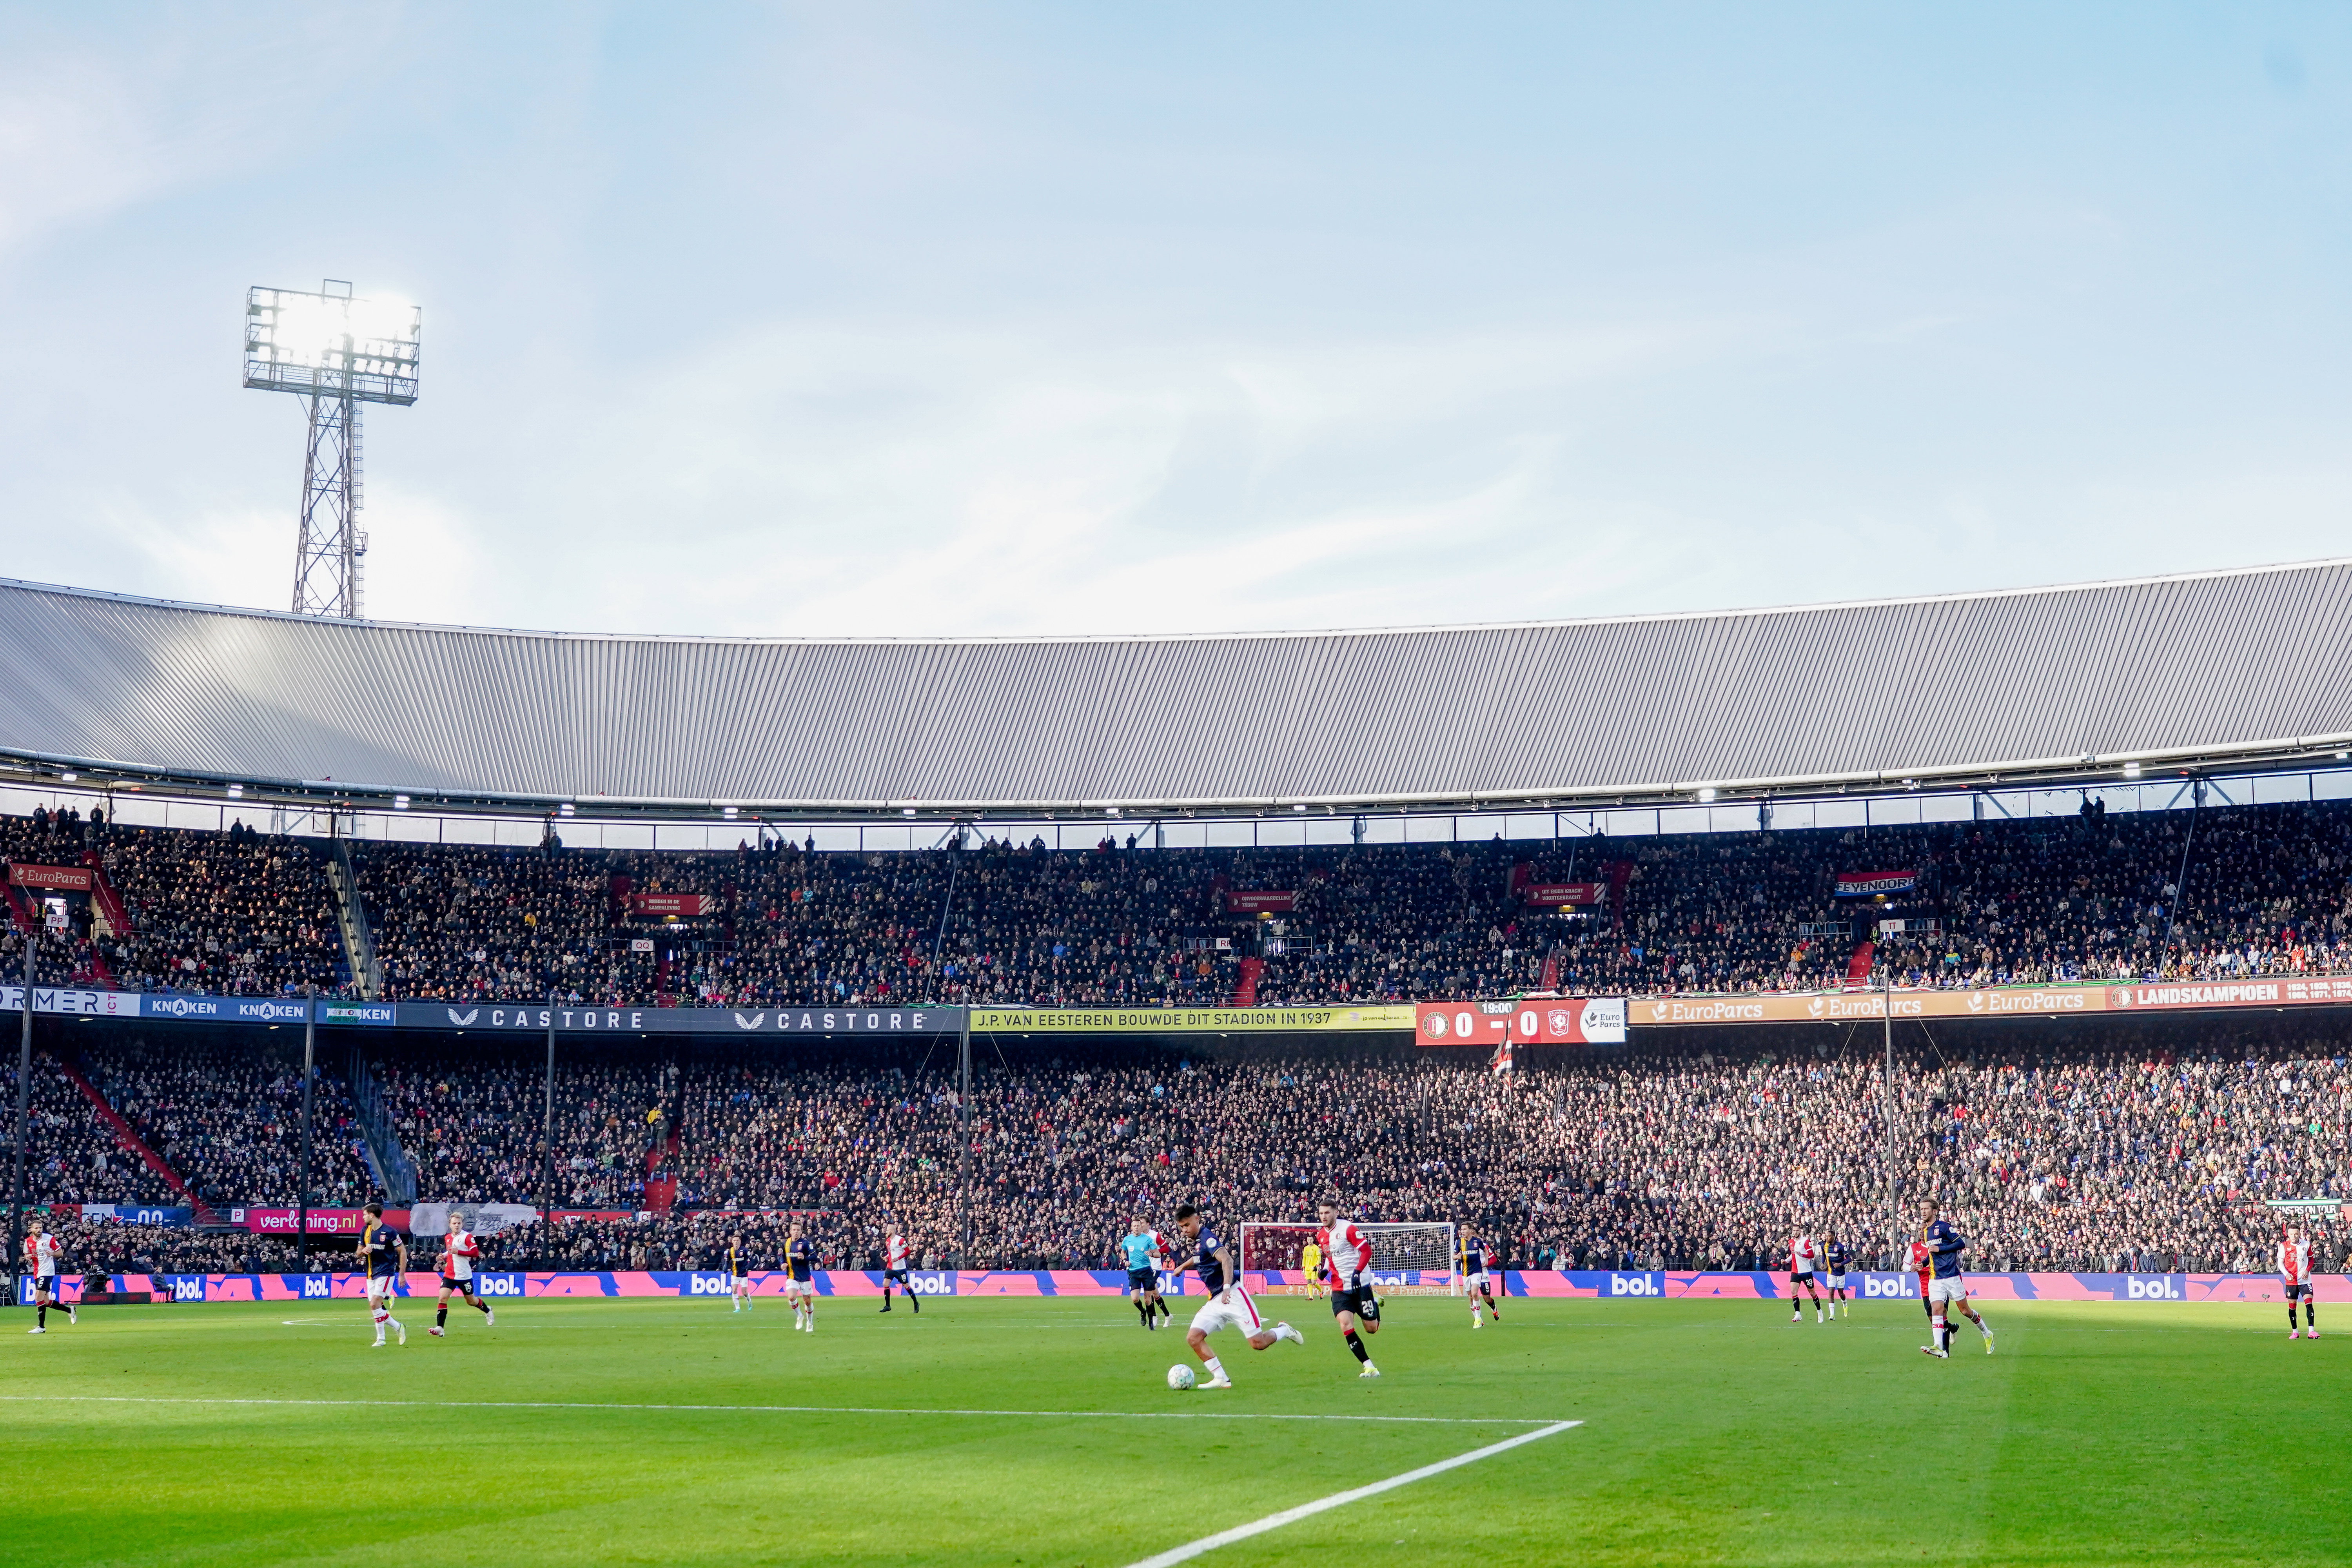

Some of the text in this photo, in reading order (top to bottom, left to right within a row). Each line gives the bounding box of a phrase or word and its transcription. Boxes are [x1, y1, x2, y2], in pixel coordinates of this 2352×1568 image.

[27, 870, 87, 885] EuroParcs
[1989, 992, 2083, 1010] EuroParcs
[2138, 984, 2278, 1005] LANDSKAMPIOEN
[2310, 990, 2331, 999] 1971,
[107, 994, 117, 1014] ICT
[152, 999, 217, 1015] KNAKEN
[240, 1003, 303, 1018] KNAKEN
[1481, 1002, 1512, 1014] 19:00
[1672, 1002, 1762, 1020] EuroParcs
[1829, 998, 1921, 1016] EuroParcs
[362, 1009, 390, 1020] KEN
[492, 1010, 642, 1028] CASTORE
[778, 1013, 924, 1029] CASTORE
[978, 1013, 1331, 1026] J.P. VAN EESTEREN BOUWDE DIT STADION IN 1937
[1455, 1012, 1473, 1037] 0
[1520, 1011, 1537, 1036] 0
[235, 1211, 241, 1220] P
[2305, 1206, 2316, 1214] ON
[2317, 1205, 2336, 1214] TOUR
[260, 1210, 356, 1232] verloning.nl
[176, 1277, 203, 1299] bol.
[305, 1275, 328, 1296] bol.
[480, 1274, 520, 1295] bol.
[691, 1273, 732, 1294] bol.
[909, 1273, 951, 1294] bol.
[1399, 1286, 1451, 1296] EuroParc
[1612, 1273, 1659, 1295] bol.
[1864, 1274, 1913, 1297] bol.
[2128, 1276, 2179, 1299] bol.
[1361, 1299, 1374, 1313] 29
